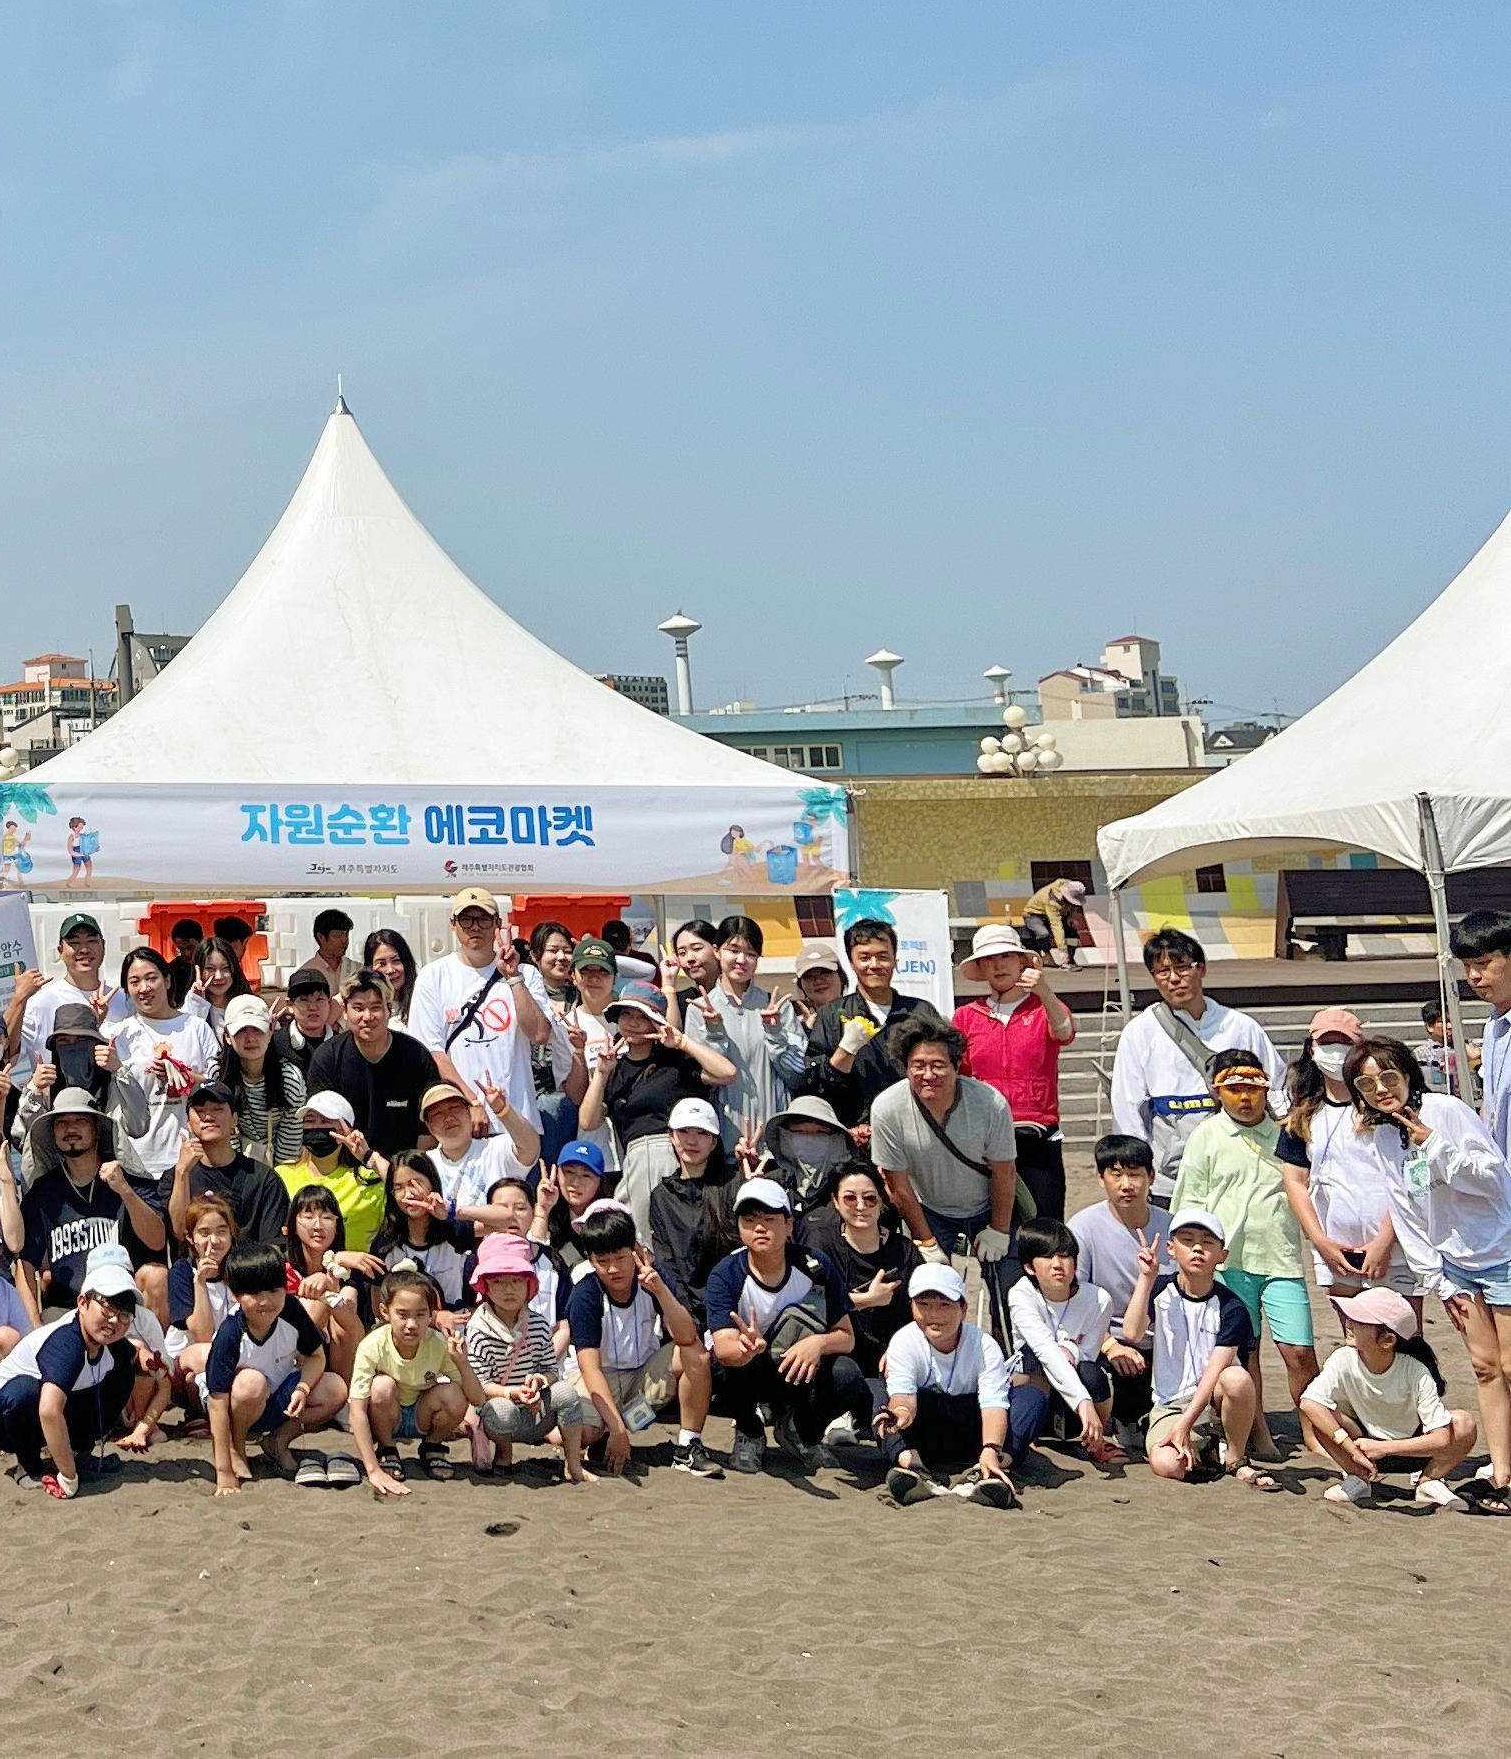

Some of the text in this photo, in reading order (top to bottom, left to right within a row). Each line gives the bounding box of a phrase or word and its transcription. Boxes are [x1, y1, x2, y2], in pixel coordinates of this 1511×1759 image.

[240, 803, 596, 846] 자원순환 에코마켓
[338, 864, 400, 874] 제주특별자치도
